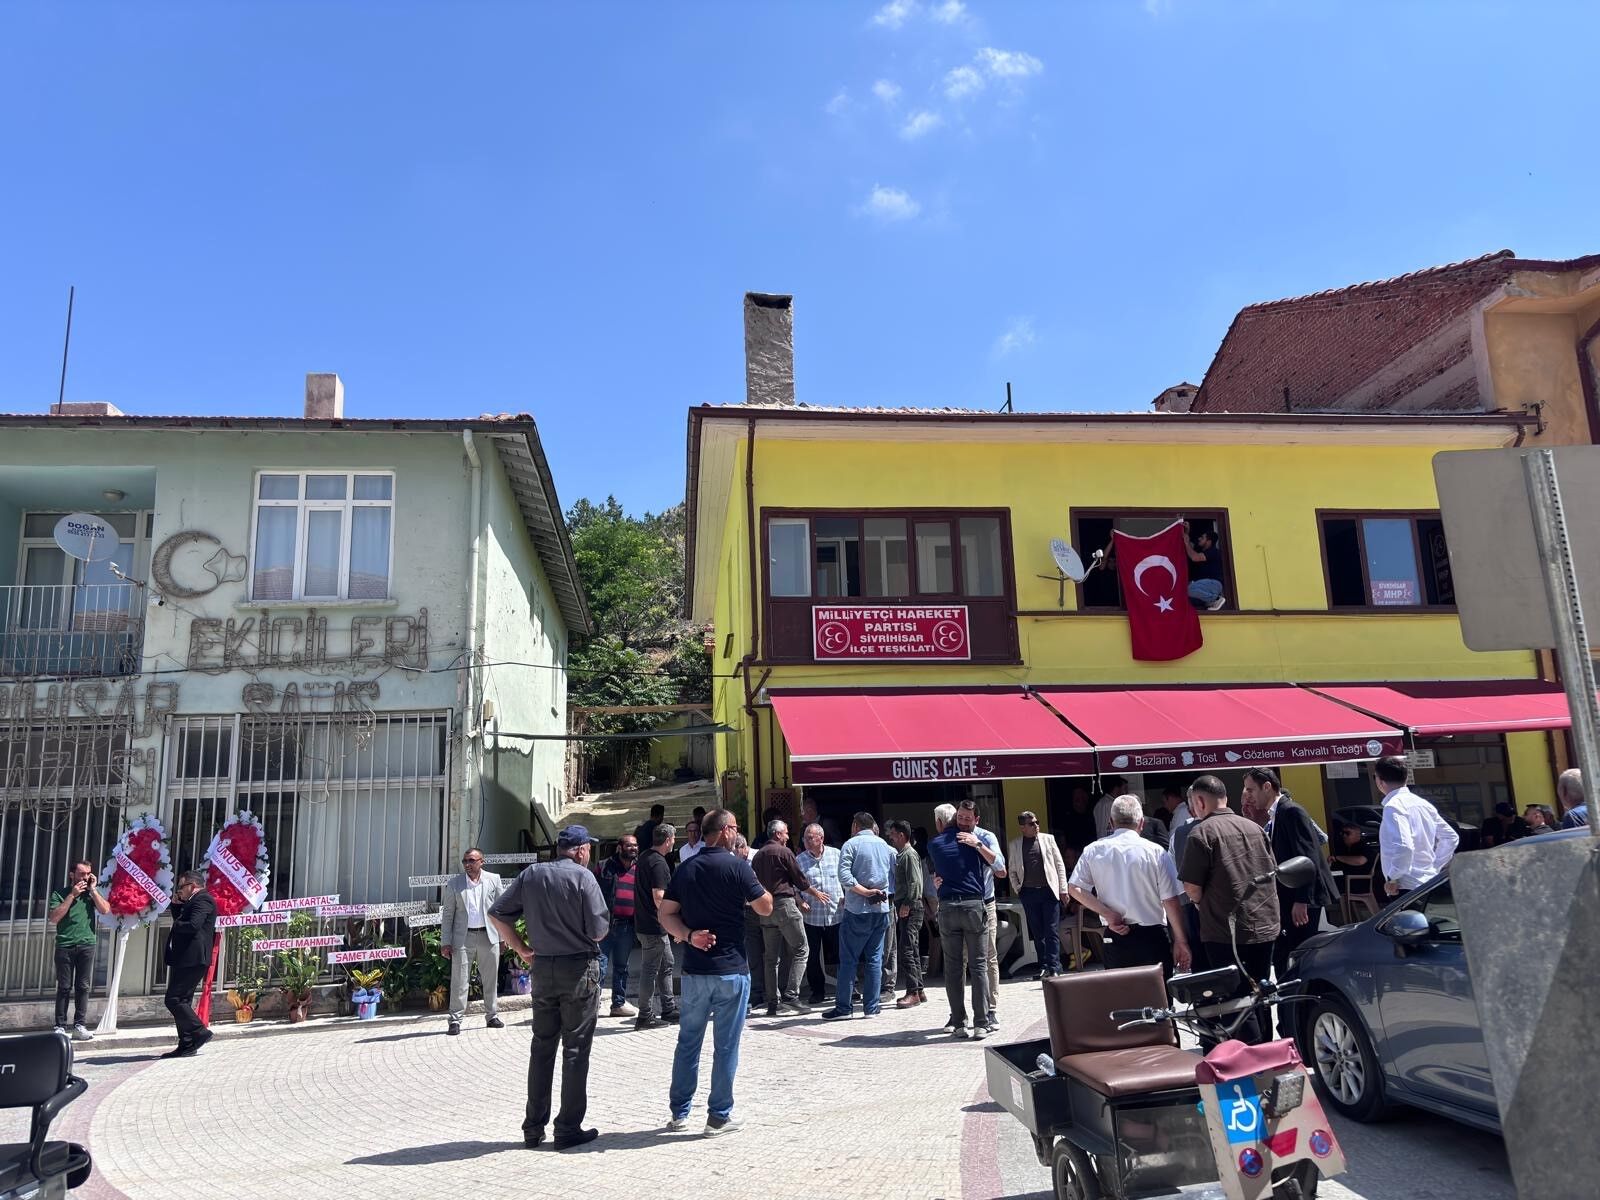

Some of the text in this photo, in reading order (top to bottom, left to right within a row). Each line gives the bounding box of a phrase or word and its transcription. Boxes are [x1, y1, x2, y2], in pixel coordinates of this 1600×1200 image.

[1383, 590, 1403, 599] MHP
[897, 609, 961, 619] HAREKET
[860, 633, 924, 643] SİVRİHİSAR
[850, 644, 935, 654] İLÇE TEŞKİLATI
[1135, 744, 1363, 766] Bazlama Tost Gözleme Kahvaltı Tabağı
[892, 756, 979, 781] GÜNEŞ CAFE
[242, 869, 263, 894] YER
[268, 896, 331, 910] MURAT KARTAL
[219, 911, 282, 926] KÖK TRAKTÖR
[295, 936, 335, 948] MAHMUT
[335, 951, 367, 962] SAMET
